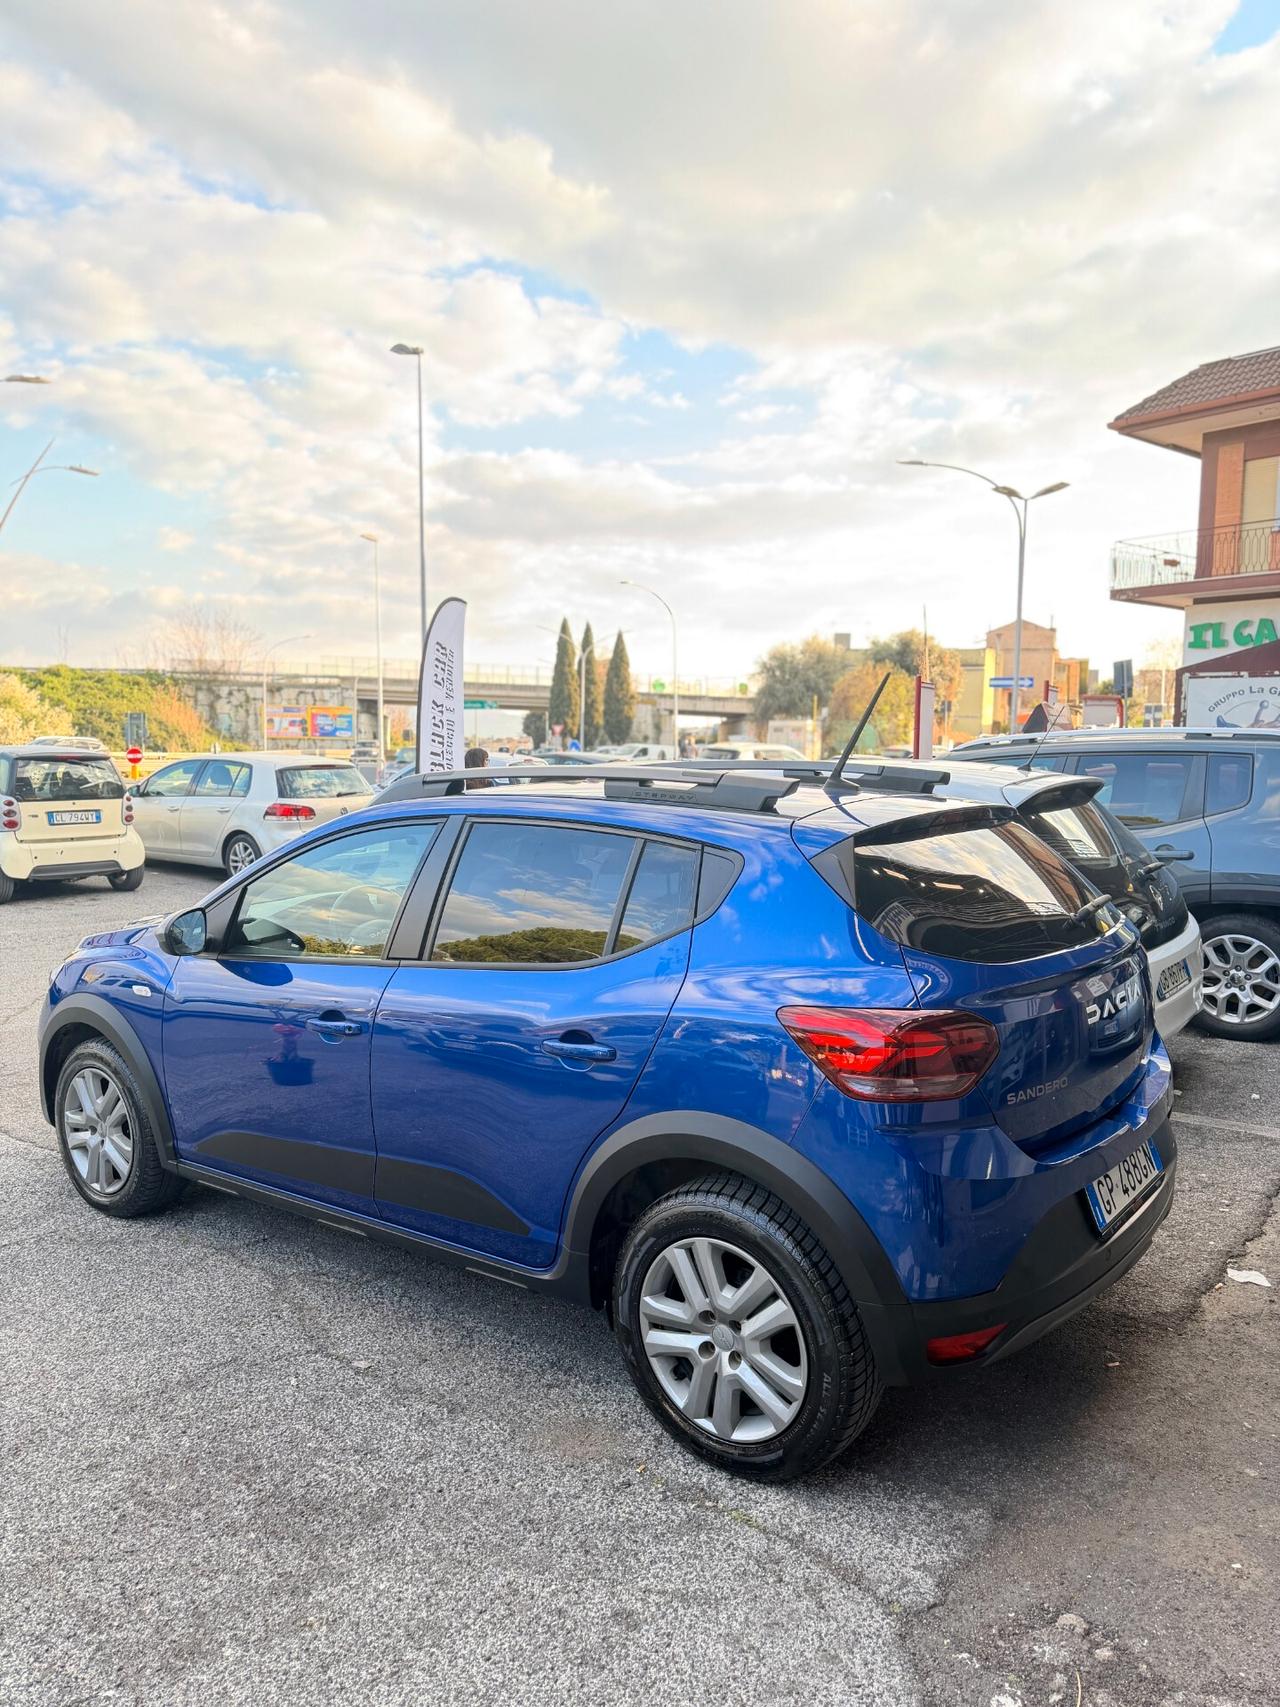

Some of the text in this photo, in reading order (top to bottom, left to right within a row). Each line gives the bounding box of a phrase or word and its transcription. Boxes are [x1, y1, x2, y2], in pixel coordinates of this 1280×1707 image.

[1187, 622, 1228, 649] IL
[429, 641, 448, 771] BLACK CAR
[1208, 689, 1246, 712] GRUPPO
[445, 719, 455, 771] OLEGGIO
[1086, 983, 1141, 1025] DACIA
[1006, 1075, 1069, 1105] SANDERO
